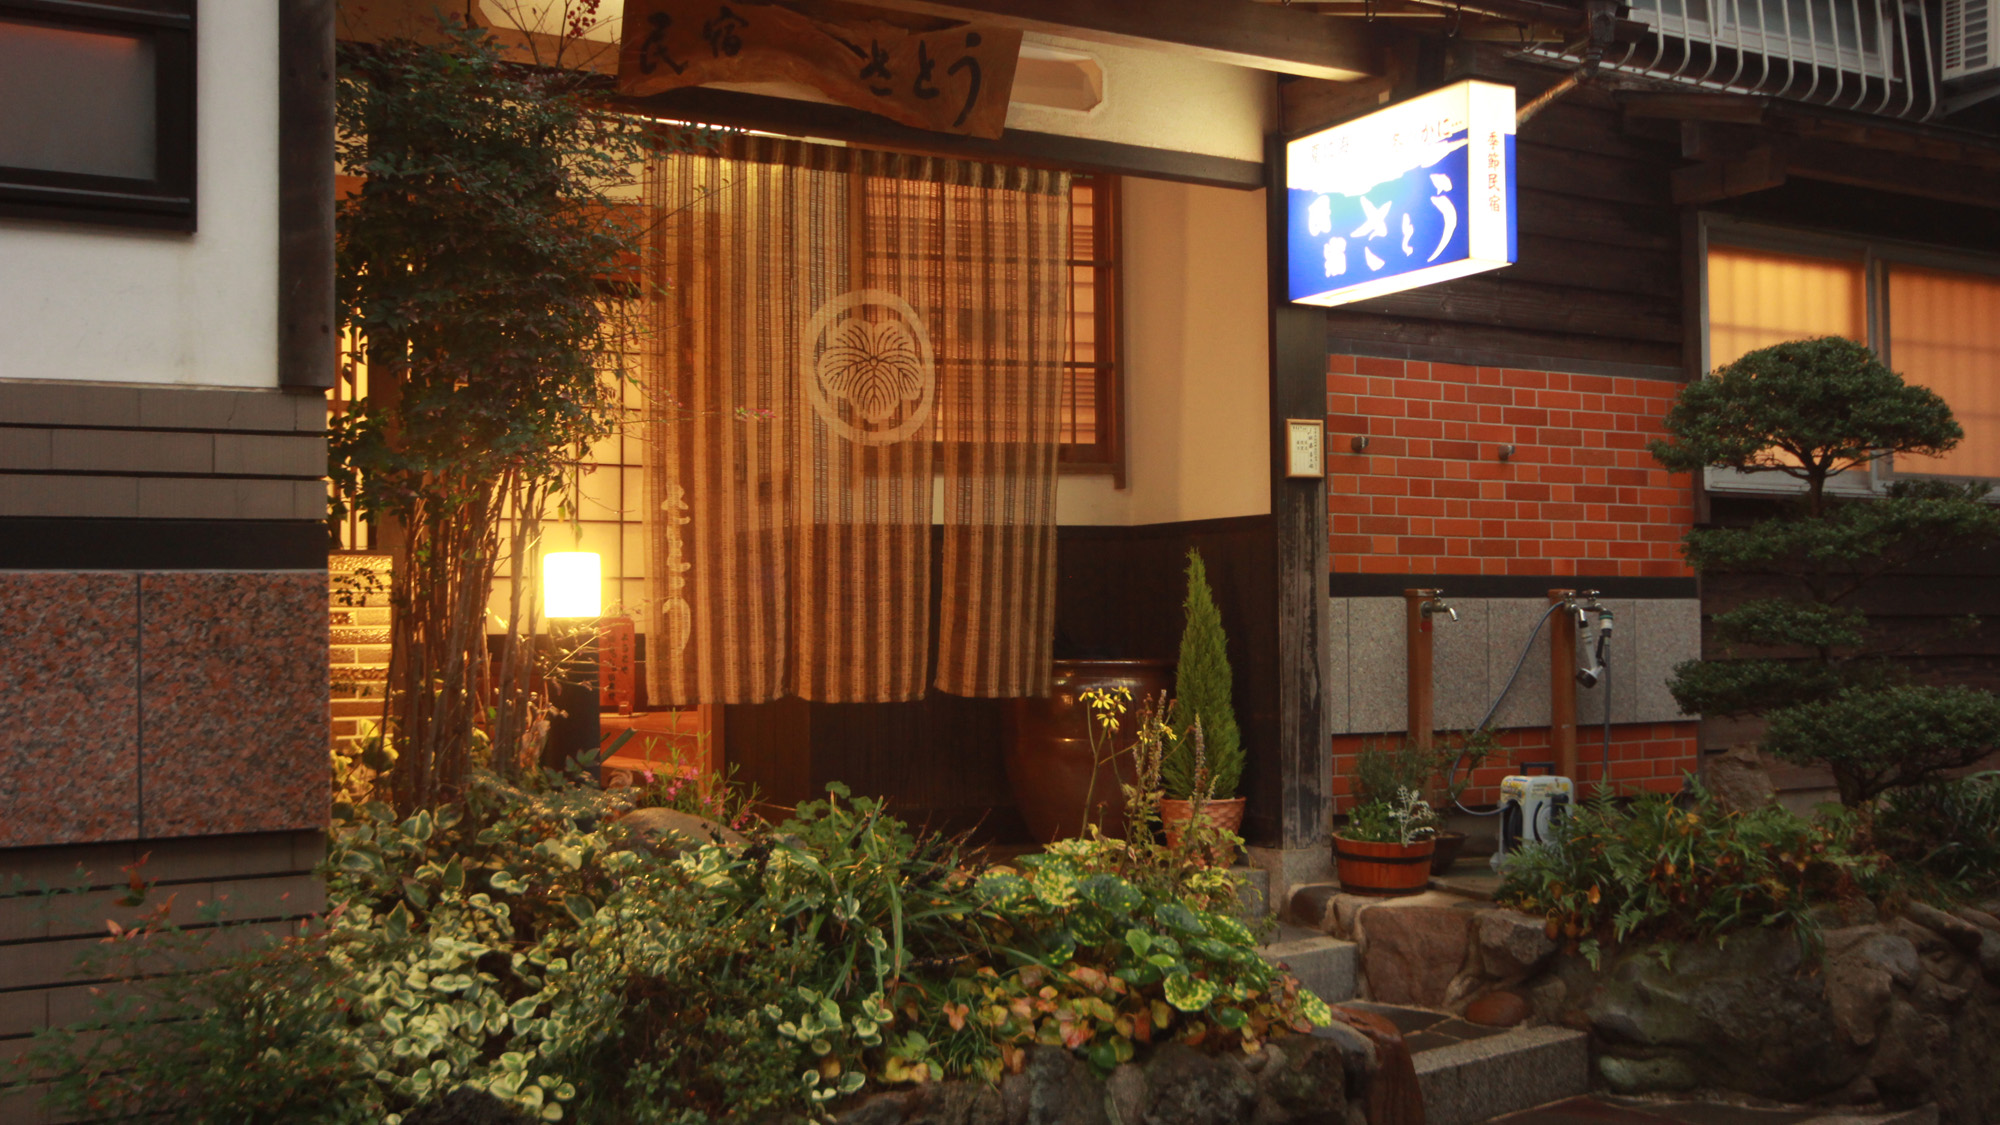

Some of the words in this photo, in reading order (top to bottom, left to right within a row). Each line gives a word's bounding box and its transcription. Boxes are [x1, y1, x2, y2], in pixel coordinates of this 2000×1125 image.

[640, 5, 749, 76] 民宿
[859, 31, 982, 128] さとう
[1487, 130, 1501, 213] 季節民宿
